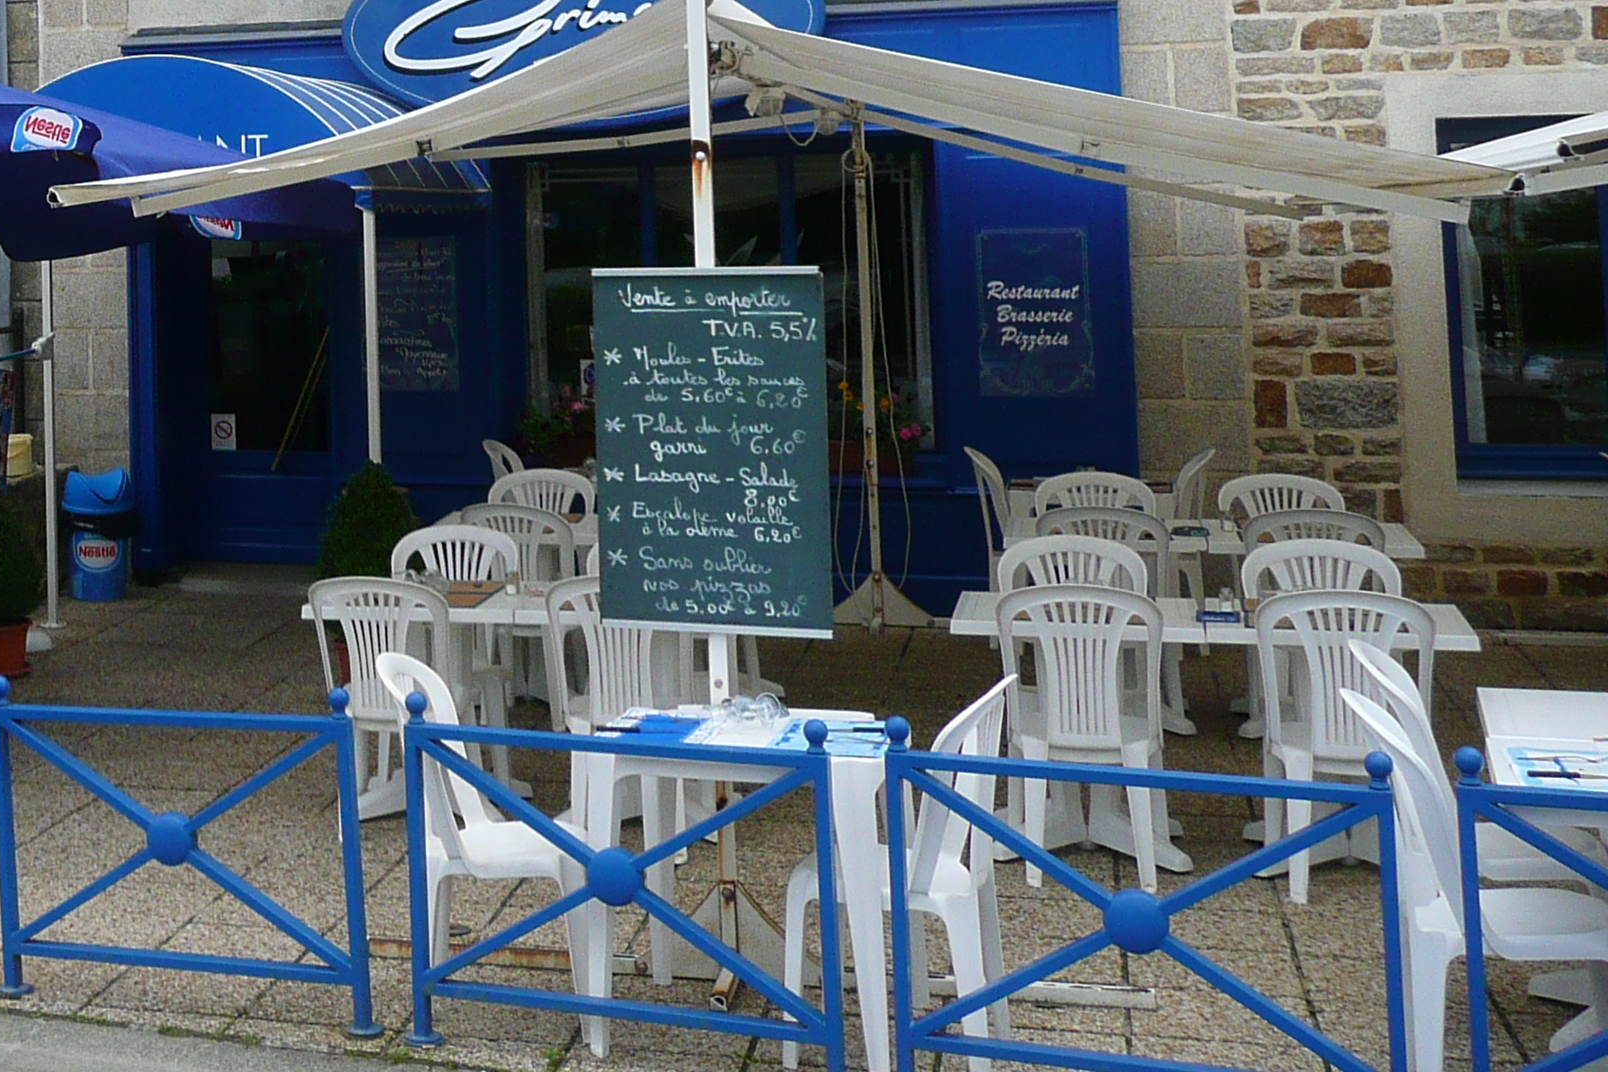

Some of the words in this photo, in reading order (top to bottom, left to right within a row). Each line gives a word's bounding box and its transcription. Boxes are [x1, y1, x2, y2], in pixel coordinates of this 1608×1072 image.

[618, 283, 676, 307] Vente
[685, 289, 697, 305] à
[705, 289, 791, 318] emporter
[986, 281, 1080, 300] Restaurant
[996, 304, 1074, 323] Brasserie
[1000, 326, 1070, 352] Pizzéria
[633, 341, 692, 371] Moules
[646, 369, 708, 386] toutes
[713, 368, 741, 386] les
[748, 375, 806, 387] sauces
[644, 389, 669, 403] de
[632, 412, 687, 435] Plat
[695, 415, 721, 433] du
[728, 414, 773, 446] jour
[650, 438, 707, 462] garni
[635, 463, 721, 493] Lasagne
[739, 462, 798, 488] Salade
[642, 523, 653, 536] à
[658, 521, 680, 537] la
[639, 546, 692, 570] Sans
[703, 546, 772, 574] oublier
[691, 576, 771, 603] pizzas
[656, 596, 680, 612] de
